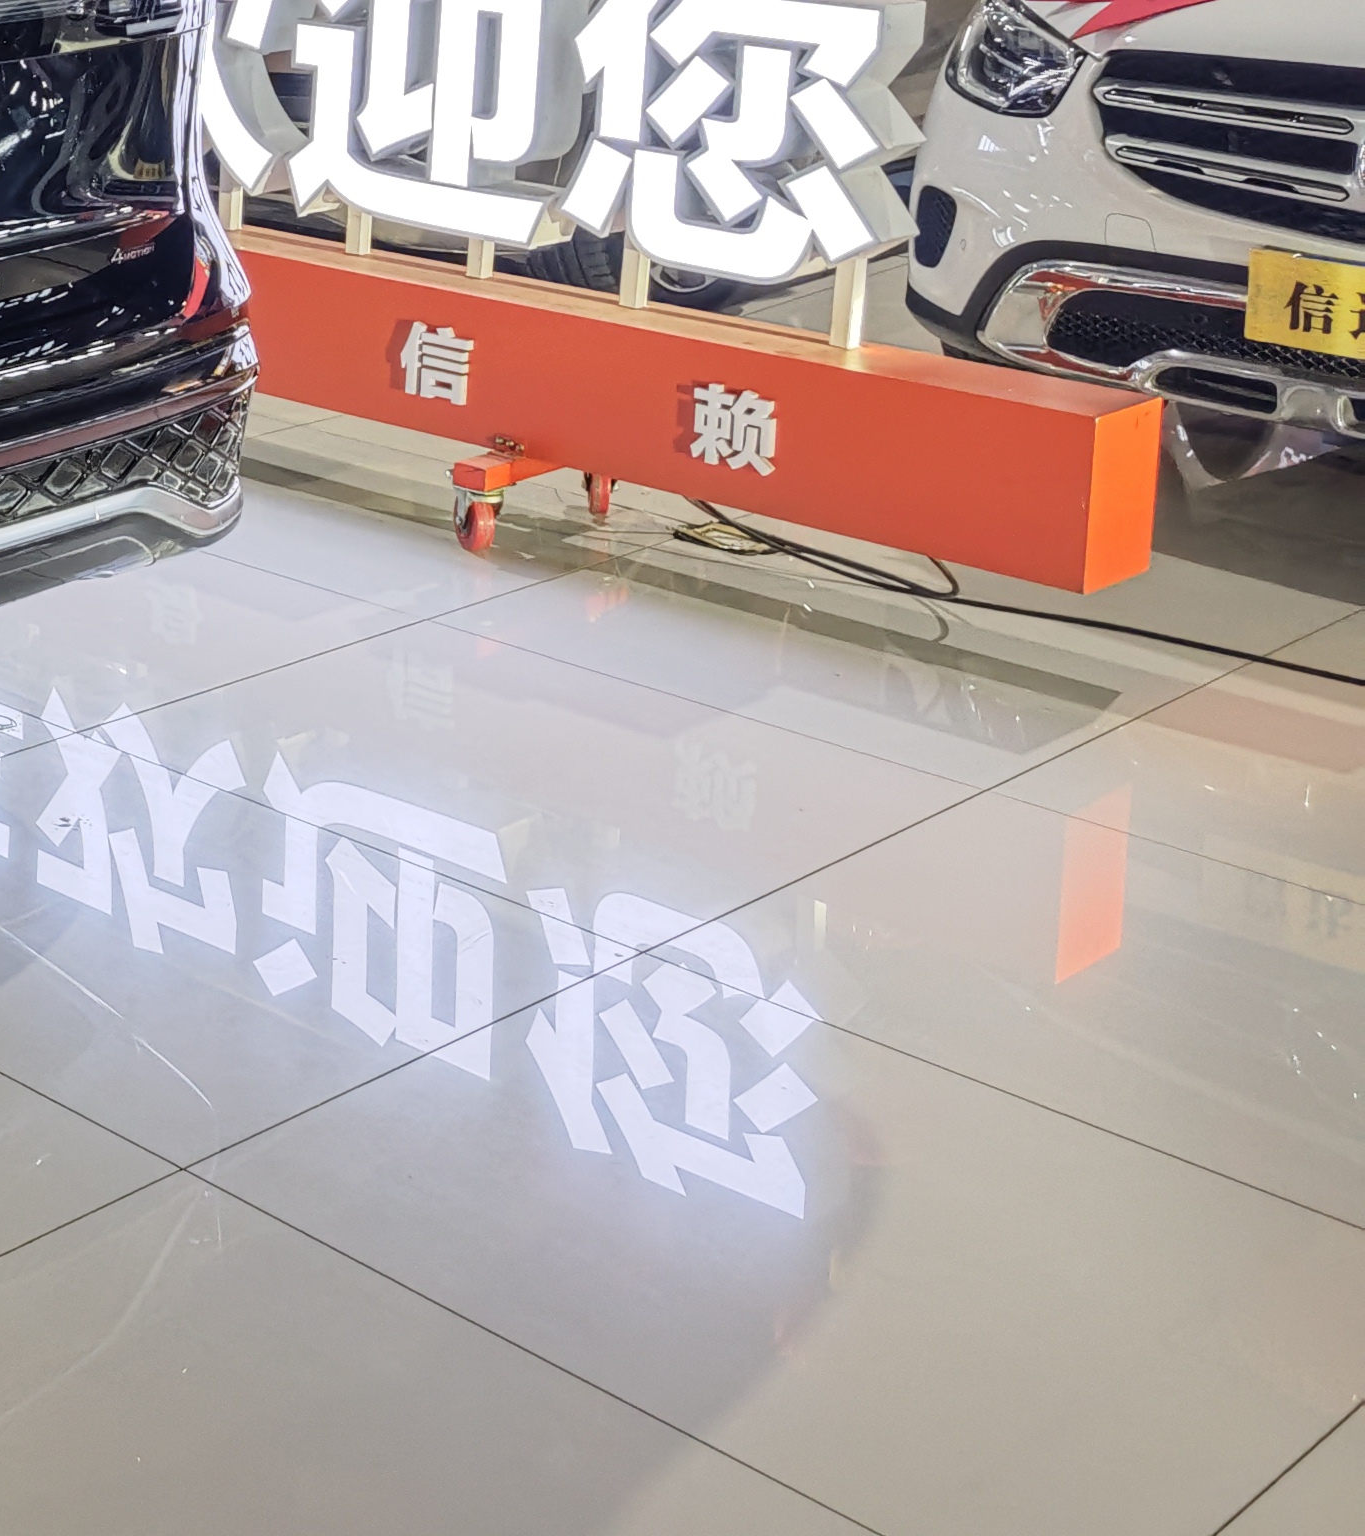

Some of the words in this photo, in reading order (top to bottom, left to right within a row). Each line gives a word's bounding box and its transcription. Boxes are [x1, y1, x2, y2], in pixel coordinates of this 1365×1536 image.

[1283, 280, 1365, 340] 信
[399, 321, 475, 407] 信
[690, 383, 778, 476] 赖
